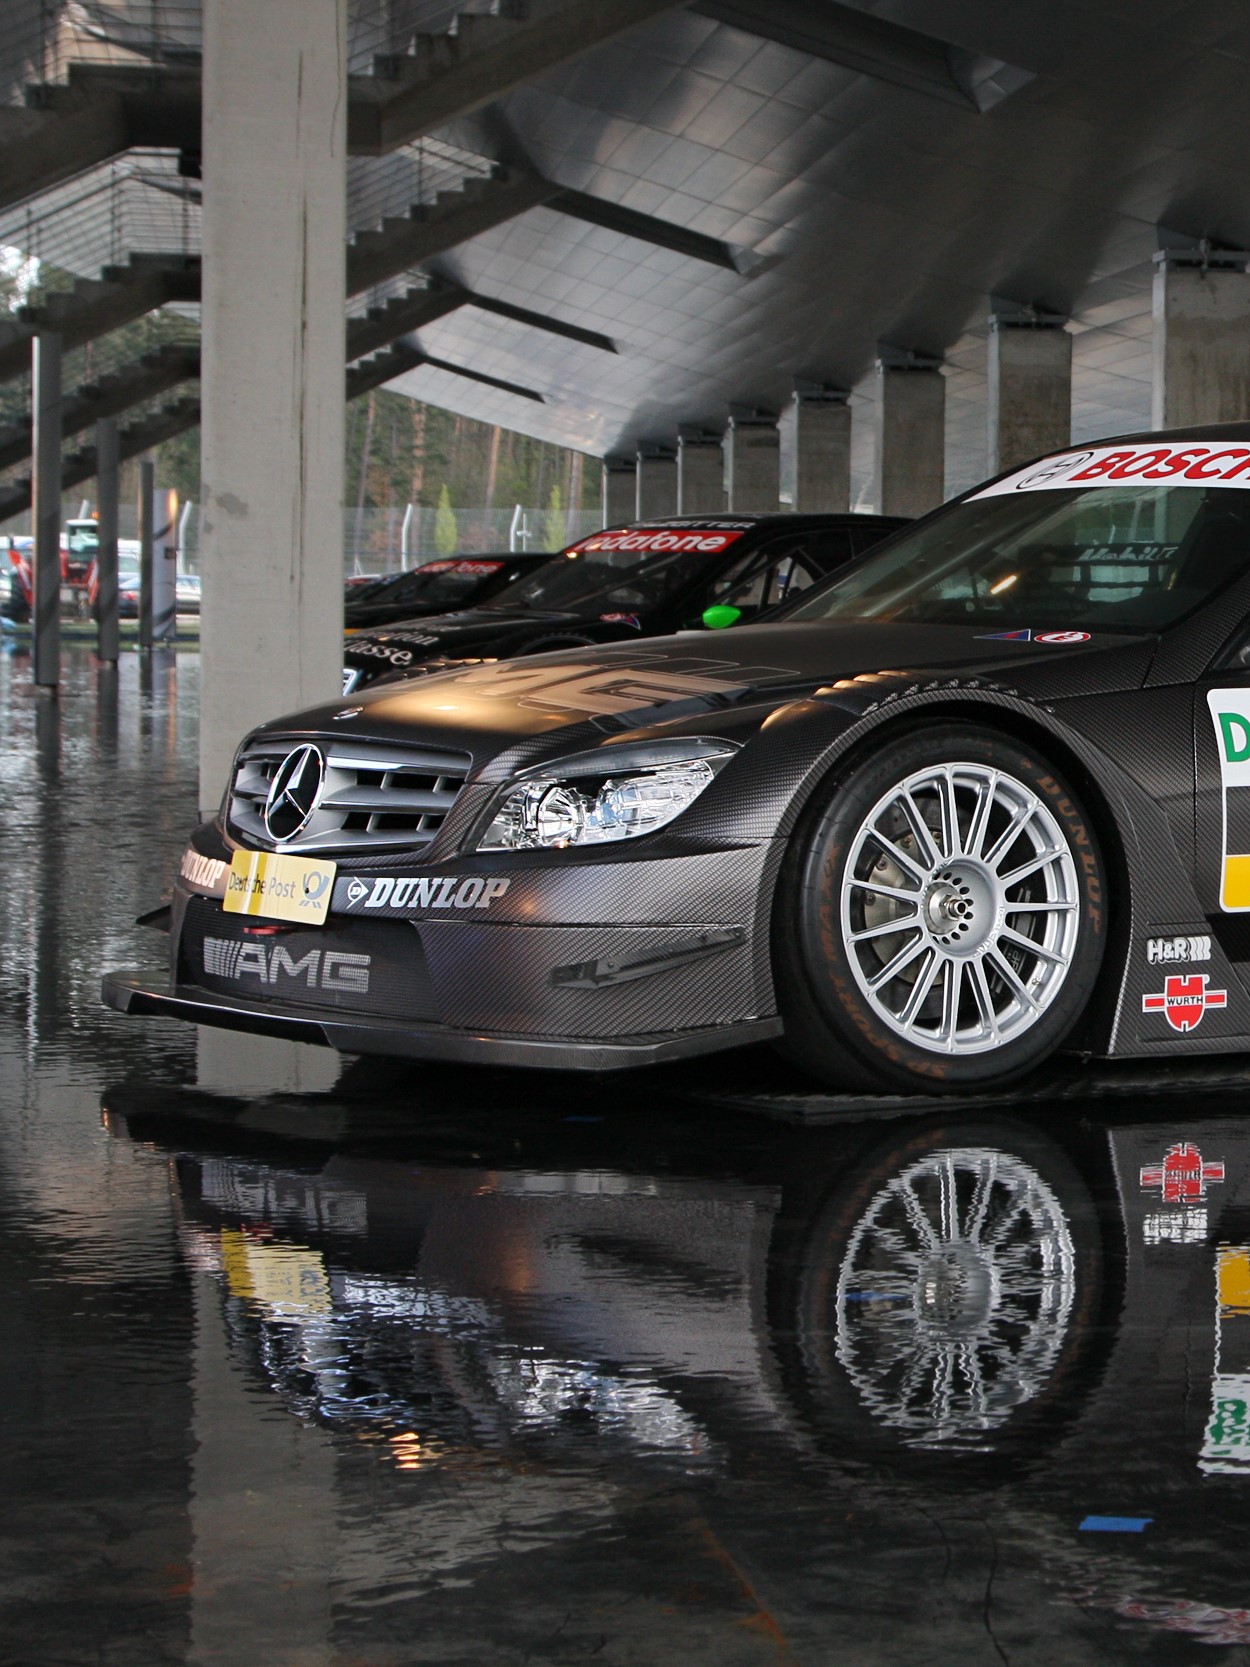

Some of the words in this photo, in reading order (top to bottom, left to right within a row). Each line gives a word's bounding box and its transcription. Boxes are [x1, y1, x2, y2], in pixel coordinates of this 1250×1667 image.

[574, 531, 728, 550] vodafone
[1034, 768, 1101, 934] DUNLOP
[180, 849, 226, 888] DUNLOP
[268, 876, 296, 898] Post
[364, 877, 510, 908] DUNLOP
[1147, 937, 1191, 965] H&R
[233, 942, 371, 993] AMG
